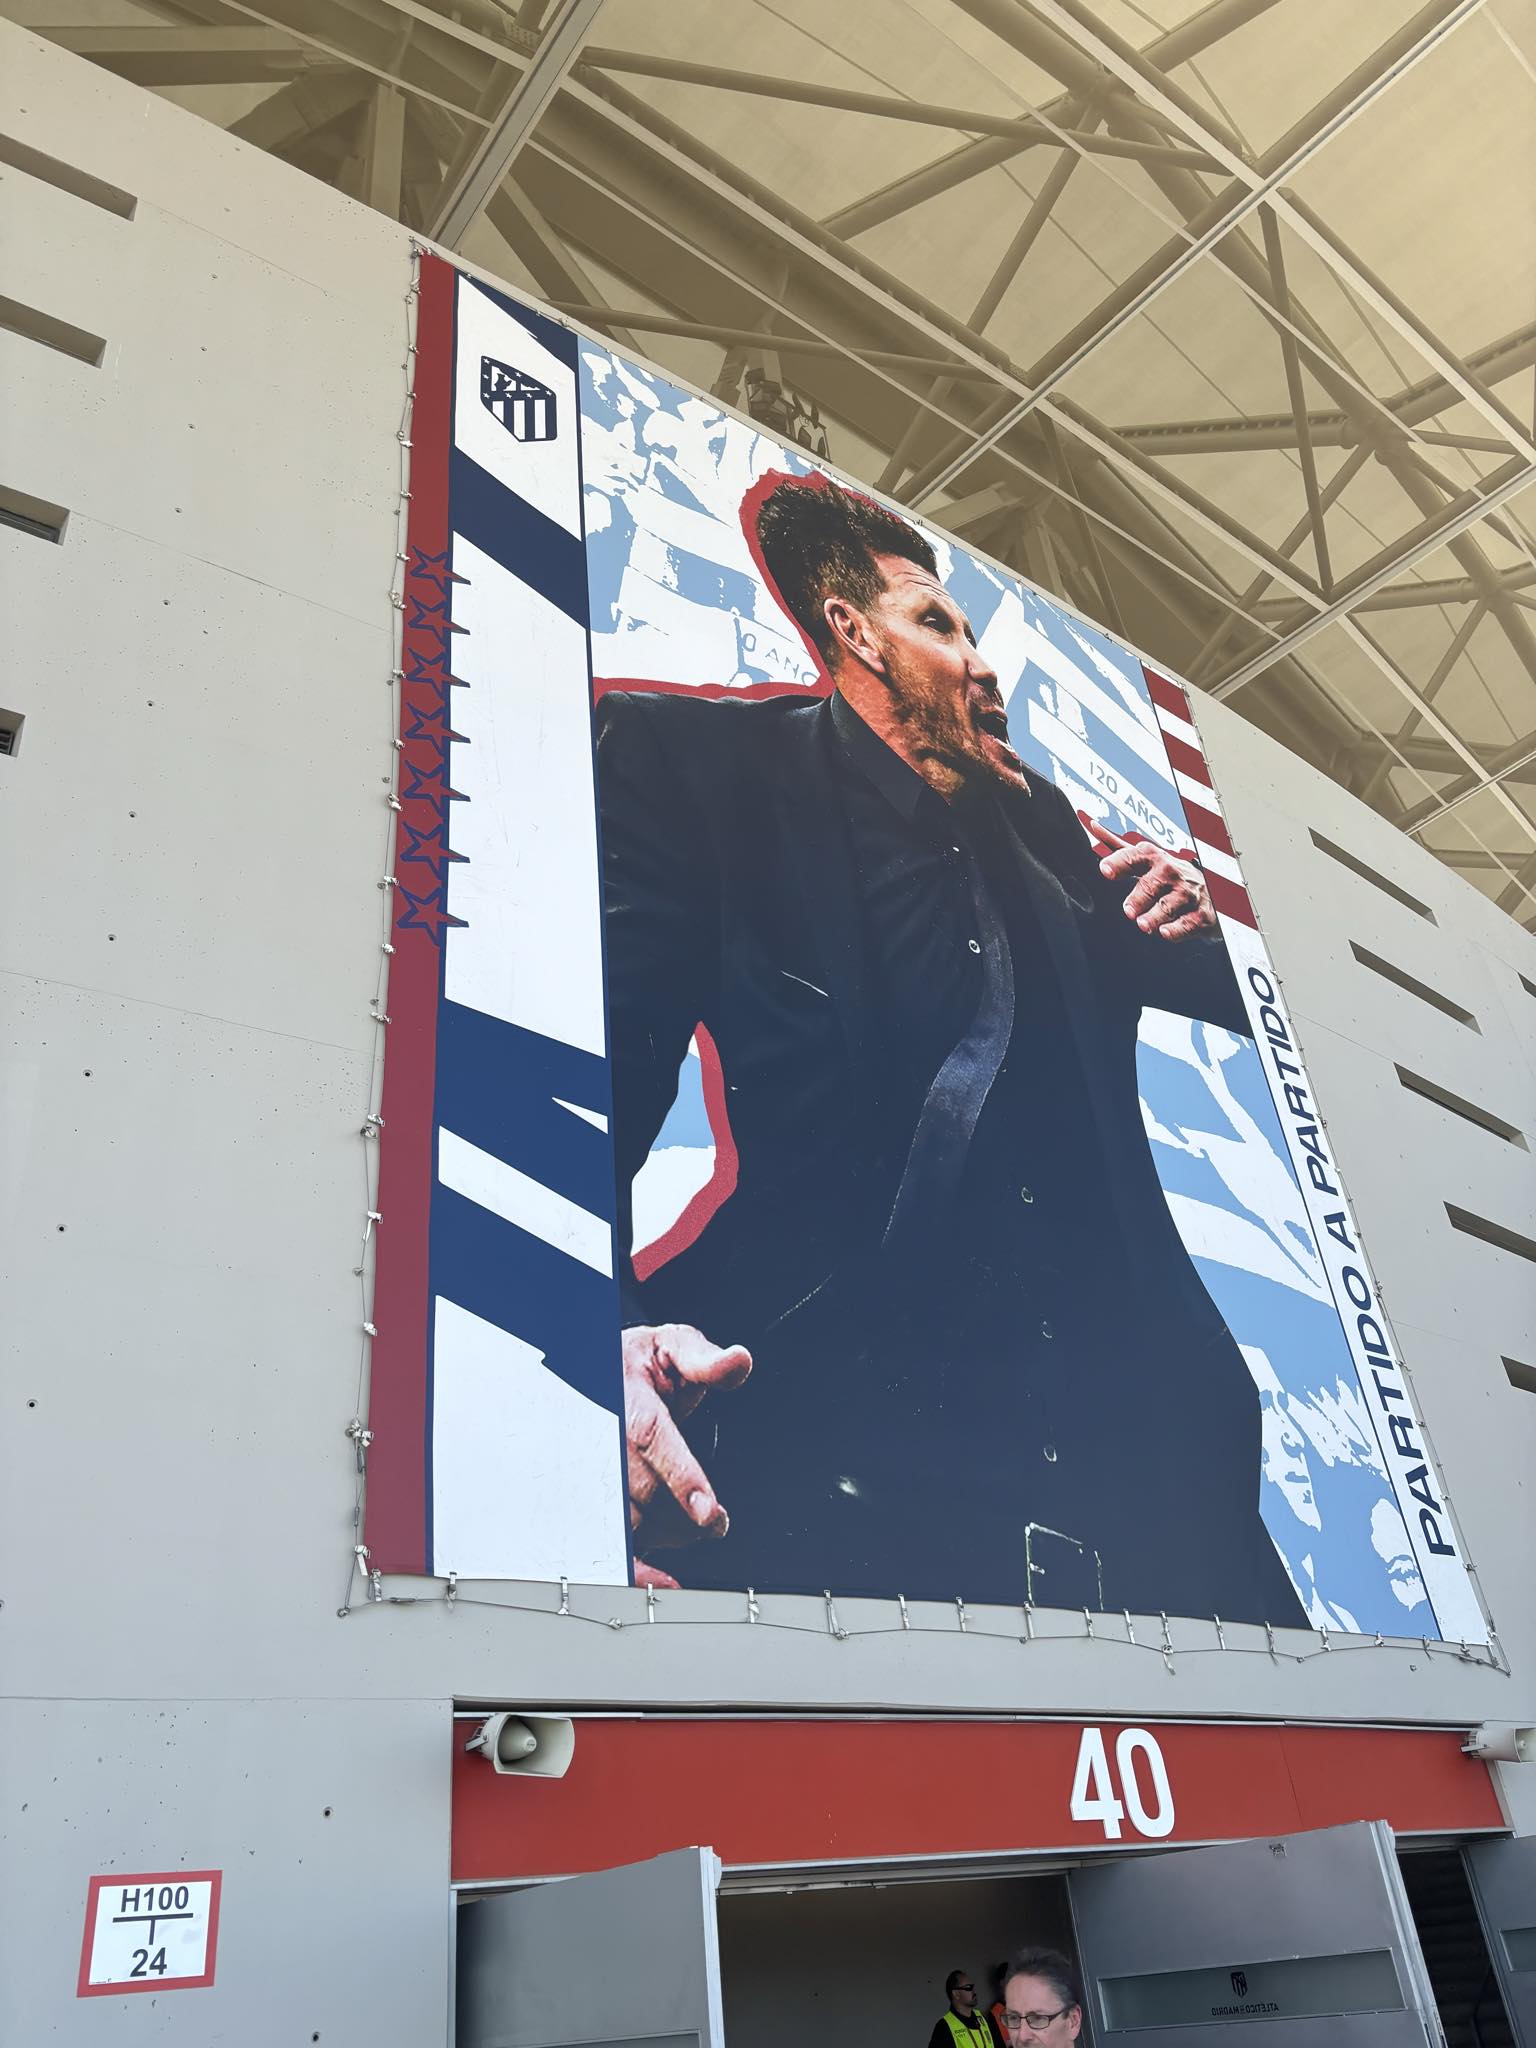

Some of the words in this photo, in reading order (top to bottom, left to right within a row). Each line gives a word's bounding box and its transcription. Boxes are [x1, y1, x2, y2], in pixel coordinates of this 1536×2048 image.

[1089, 761, 1118, 795] 120
[1124, 794, 1176, 846] AÑOS
[1247, 966, 1339, 1197] PARTIDO
[1323, 1211, 1358, 1254] A
[1341, 1265, 1457, 1557] PARTIDO
[1069, 1727, 1175, 1839] 40
[120, 1885, 190, 1913] H100
[129, 1946, 168, 1978] 24
